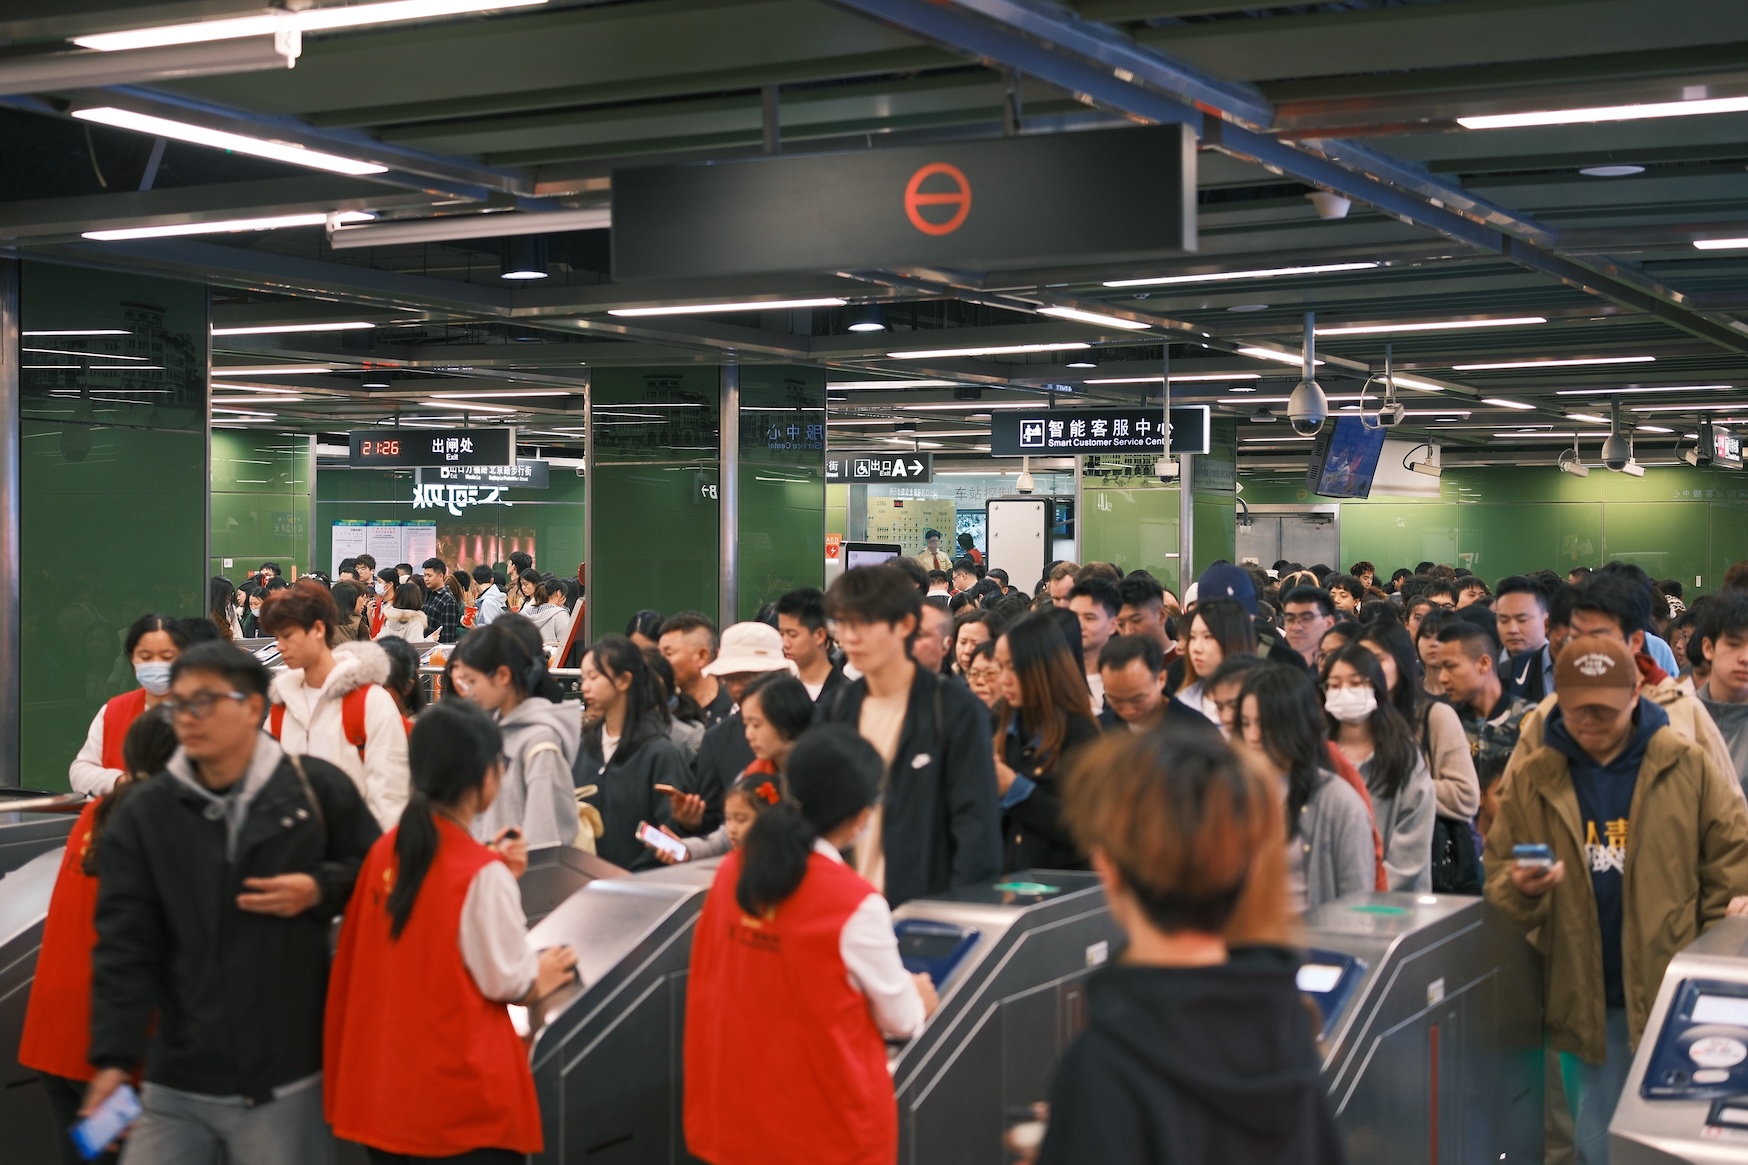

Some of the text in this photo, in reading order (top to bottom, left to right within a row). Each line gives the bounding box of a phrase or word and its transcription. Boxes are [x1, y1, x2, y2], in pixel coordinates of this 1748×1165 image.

[1048, 418, 1174, 437] 智能客服中心
[362, 442, 399, 454] 21:26
[432, 438, 474, 453] 出闸处
[1048, 437, 1174, 447] Smart Customer Service Centr
[446, 453, 459, 461] Exit
[826, 460, 838, 471] 街
[871, 460, 892, 471] 出口
[955, 486, 1020, 500] 车站控制
